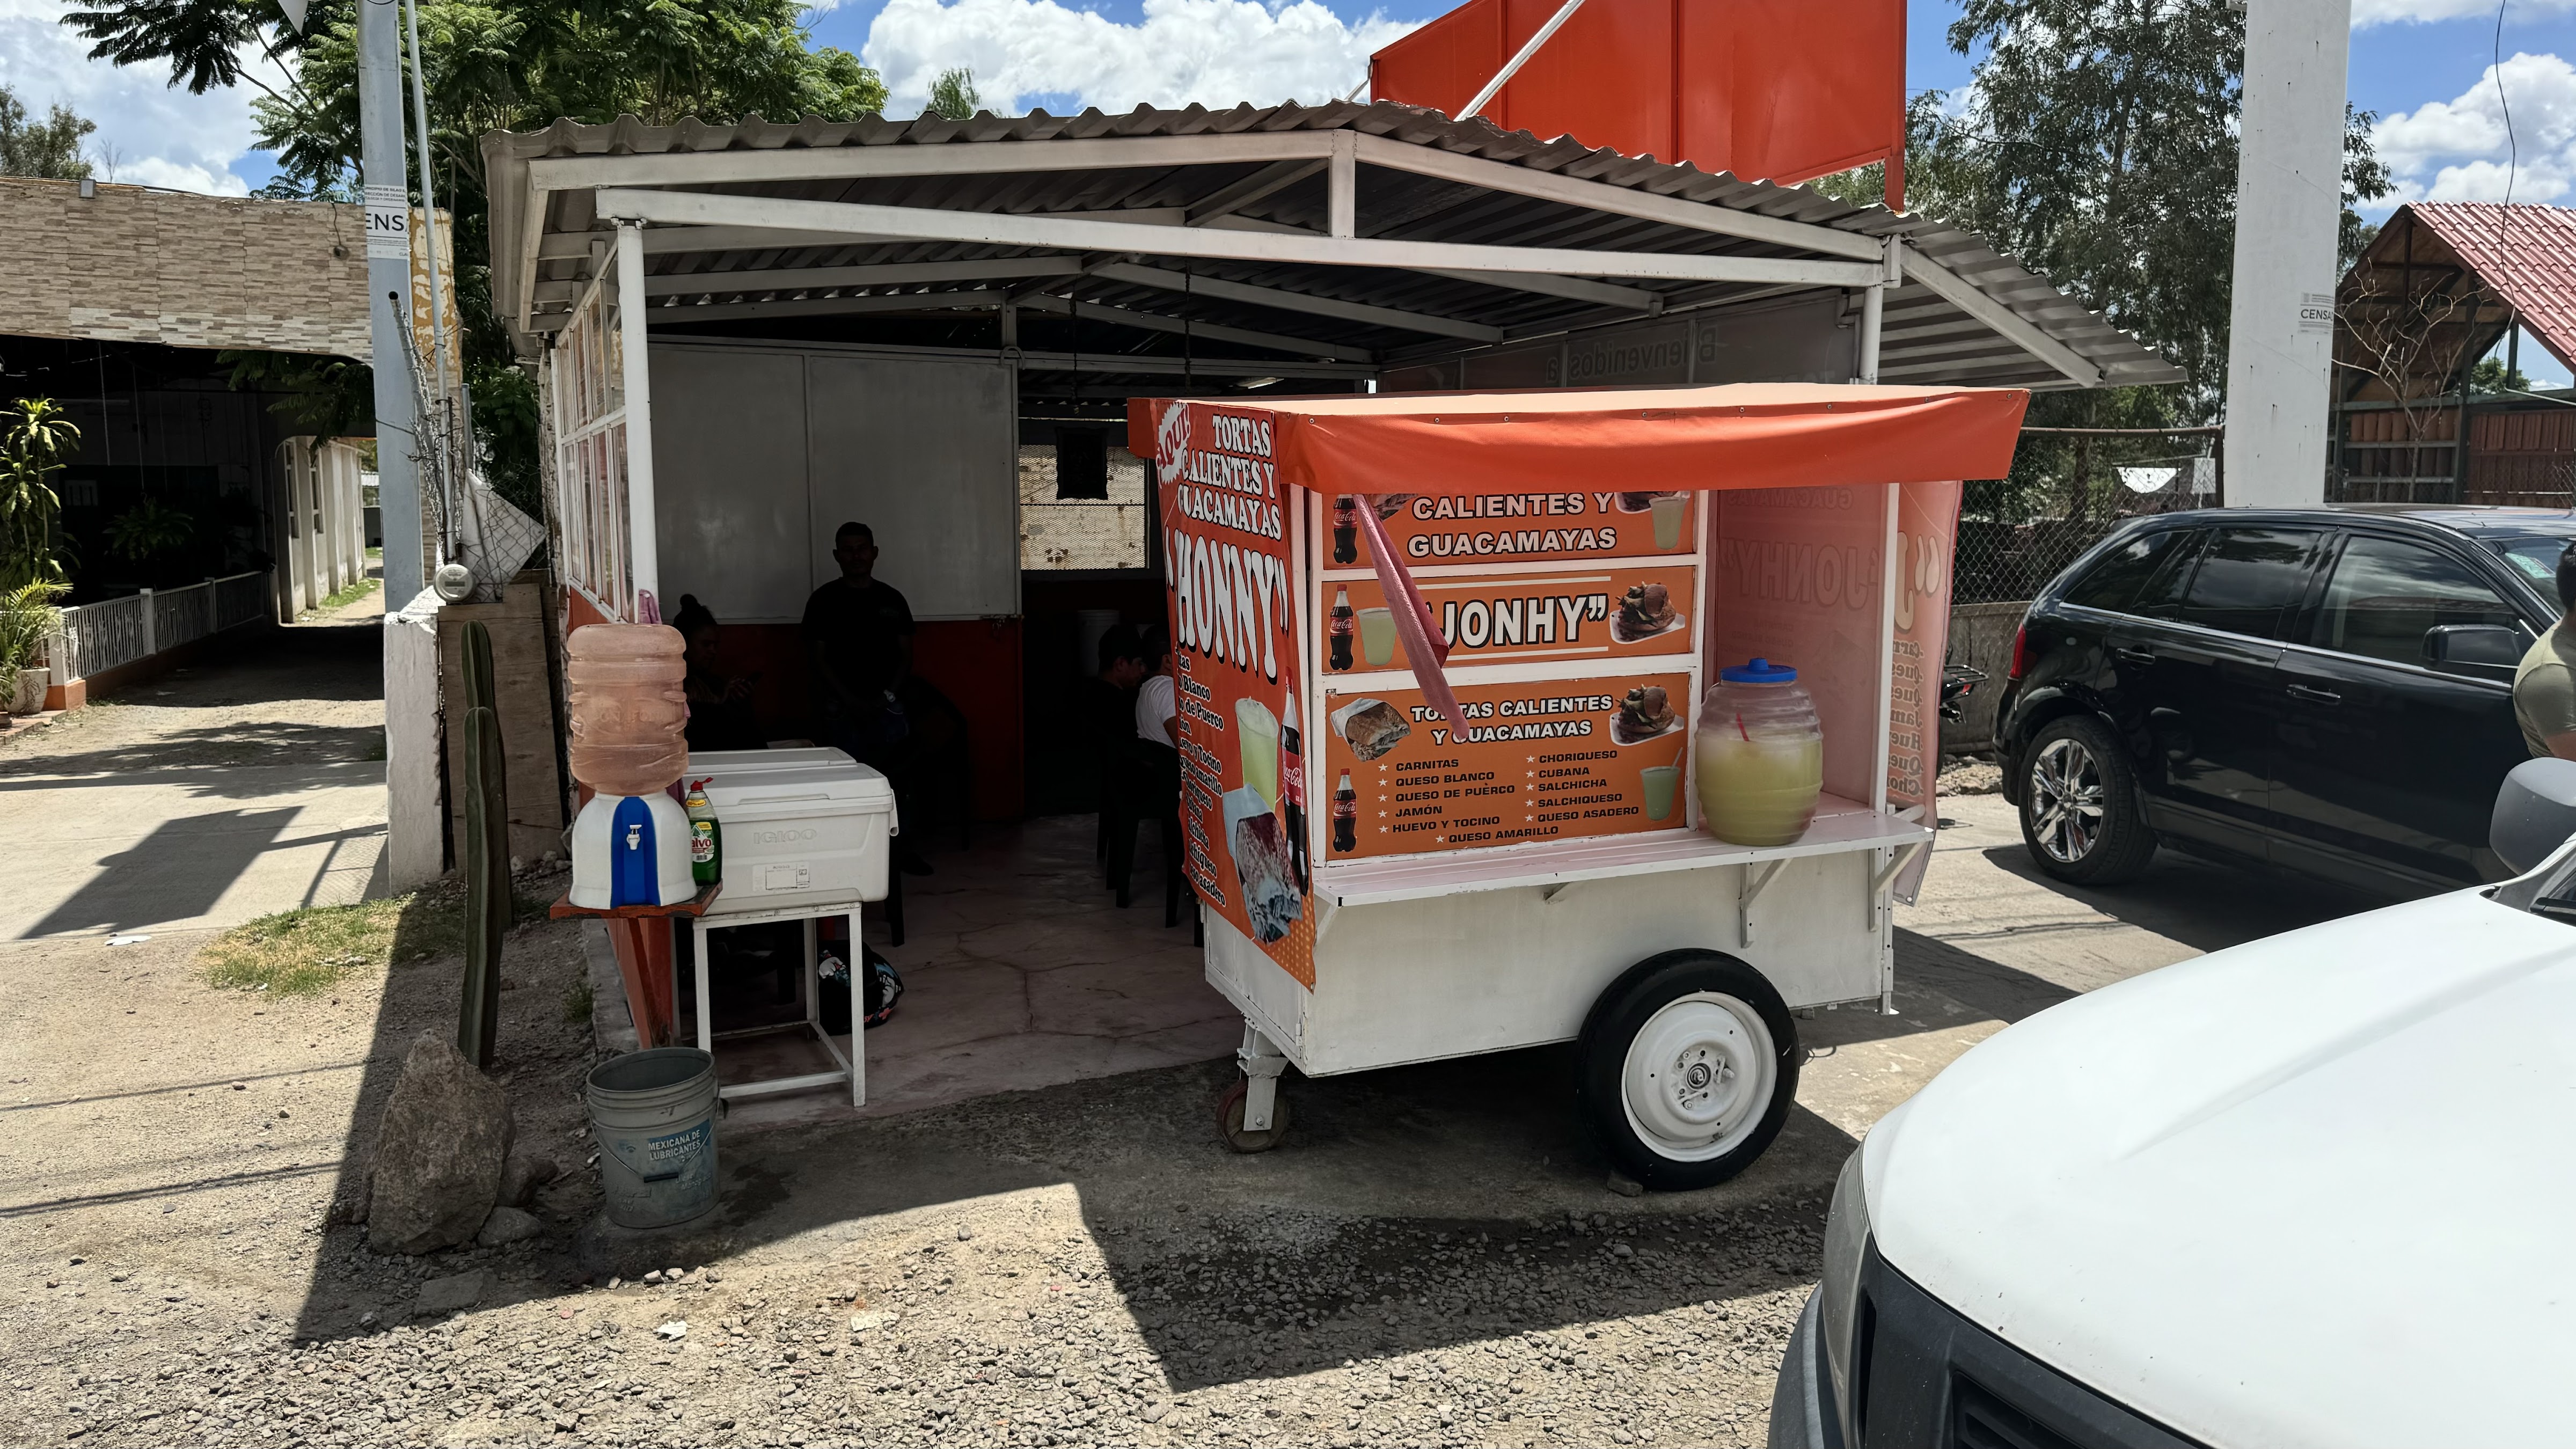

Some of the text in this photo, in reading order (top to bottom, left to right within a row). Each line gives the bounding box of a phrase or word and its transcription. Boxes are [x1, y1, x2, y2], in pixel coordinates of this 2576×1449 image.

[365, 213, 408, 233] ENS
[1212, 414, 1272, 457] TORTAS
[1181, 449, 1276, 500] CALIENTES Y
[1177, 482, 1282, 541] GUACAMAYAS
[1412, 492, 1613, 521] CALIENTES Y
[1407, 527, 1618, 558] GUACAMAYAS
[1182, 674, 1211, 702] Blanco
[1185, 697, 1197, 716] de
[1196, 700, 1225, 731] Puerco
[1410, 694, 1613, 723] TOTAS CALIENTES
[1430, 730, 1448, 747] Y
[1193, 744, 1198, 762] y
[1197, 743, 1223, 775] Tocino
[1396, 759, 1459, 771] CARNITAS
[1539, 750, 1618, 764] CHORIQUESO
[1195, 765, 1224, 799] amarillo
[1396, 772, 1495, 787] QUESO BLANCO
[1539, 766, 1590, 778] CUBANA
[1395, 791, 1439, 802] QUESO
[1444, 789, 1460, 799] DE
[1538, 779, 1607, 792] SALCHICHA
[1395, 804, 1443, 817] JAMÓN
[1538, 793, 1623, 808] SALCHIQUESO
[1392, 816, 1500, 833] HUEVO Y TOCINO
[1537, 806, 1639, 823] QUESO ASADERO
[753, 829, 817, 844] IGLOO
[1449, 825, 1558, 843] QUESO AMARILLO
[1198, 873, 1227, 908] asadero
[648, 1130, 700, 1151] MEXICANA DE
[649, 1139, 701, 1161] LUBRICANTES
